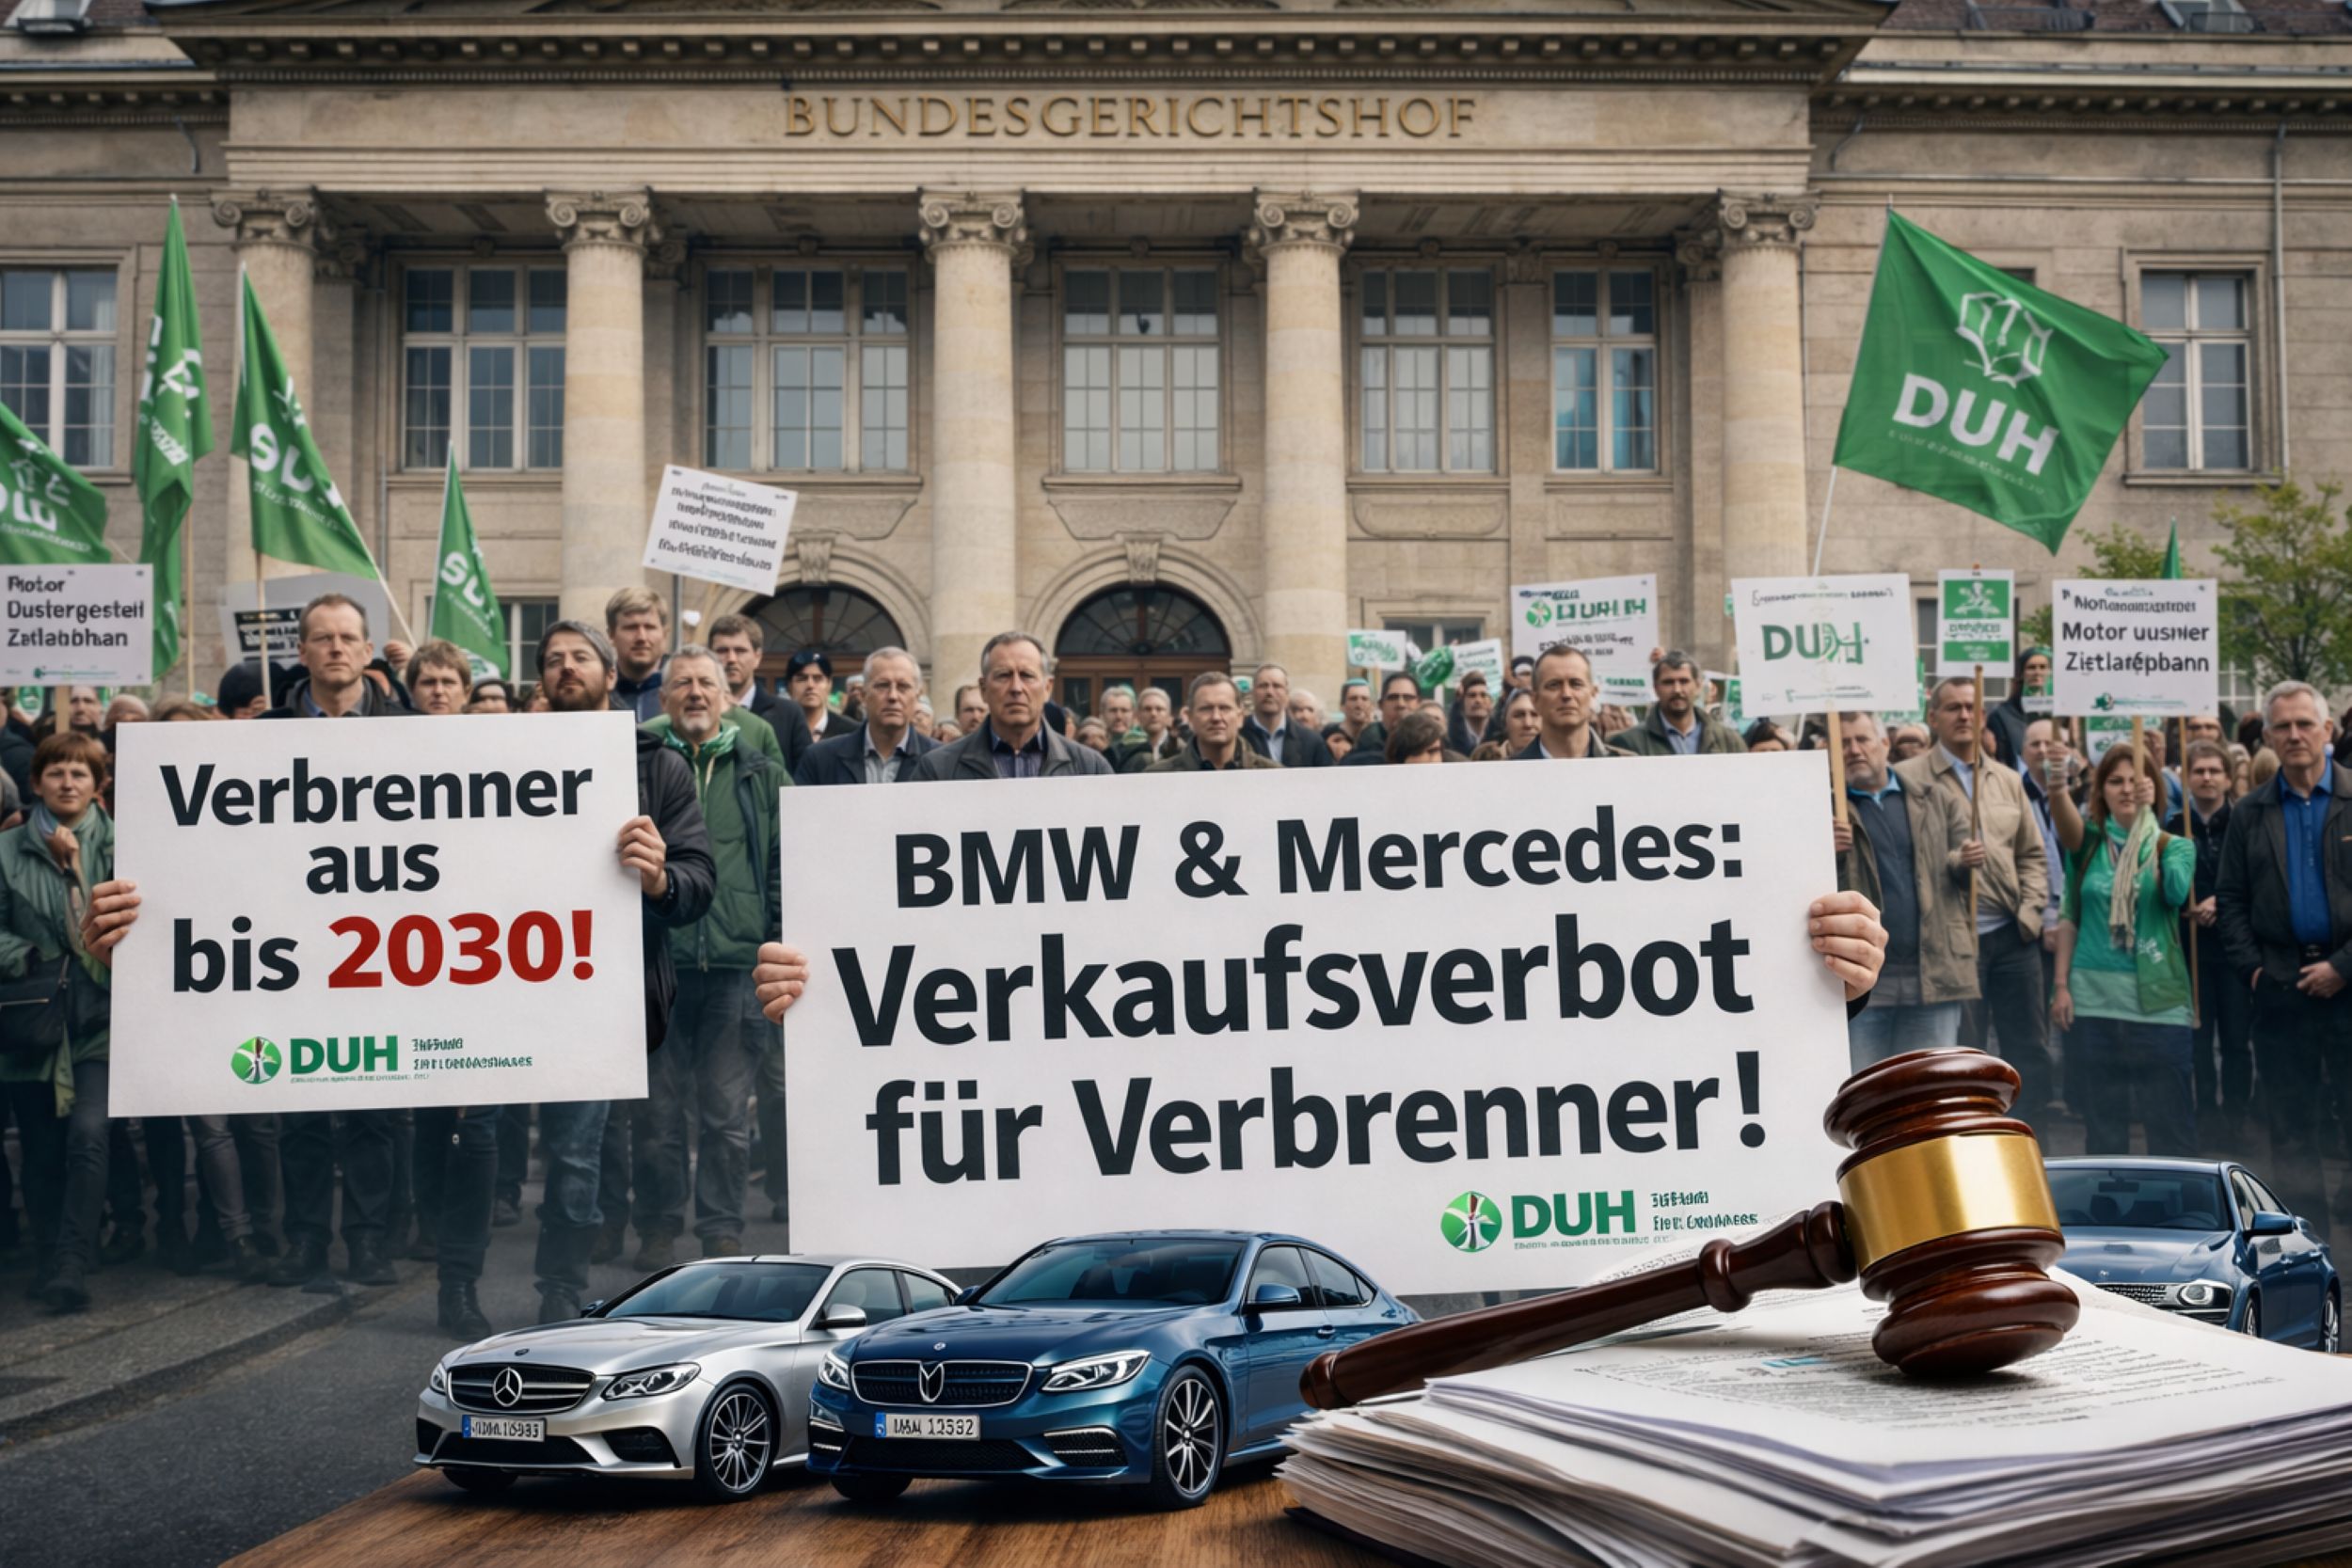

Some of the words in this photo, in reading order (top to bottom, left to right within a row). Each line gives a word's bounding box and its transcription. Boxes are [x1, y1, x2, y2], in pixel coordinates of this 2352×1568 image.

[785, 95, 1476, 138] BUNDESGERICHTSHOF
[1892, 372, 2058, 476] DUH
[2061, 622, 2127, 641] Motor
[159, 757, 593, 827] Verbrenner
[306, 843, 440, 895] aus
[895, 824, 1141, 909] BMW
[1175, 820, 1249, 899] &
[1277, 804, 1743, 895] Mercedes:
[173, 915, 300, 993] bis
[327, 910, 595, 989] 2030!
[831, 913, 1756, 1048] Verkaufsverbot
[290, 1035, 399, 1075] DUH
[866, 1079, 1043, 1186] für
[1511, 1190, 1637, 1240] DUH
